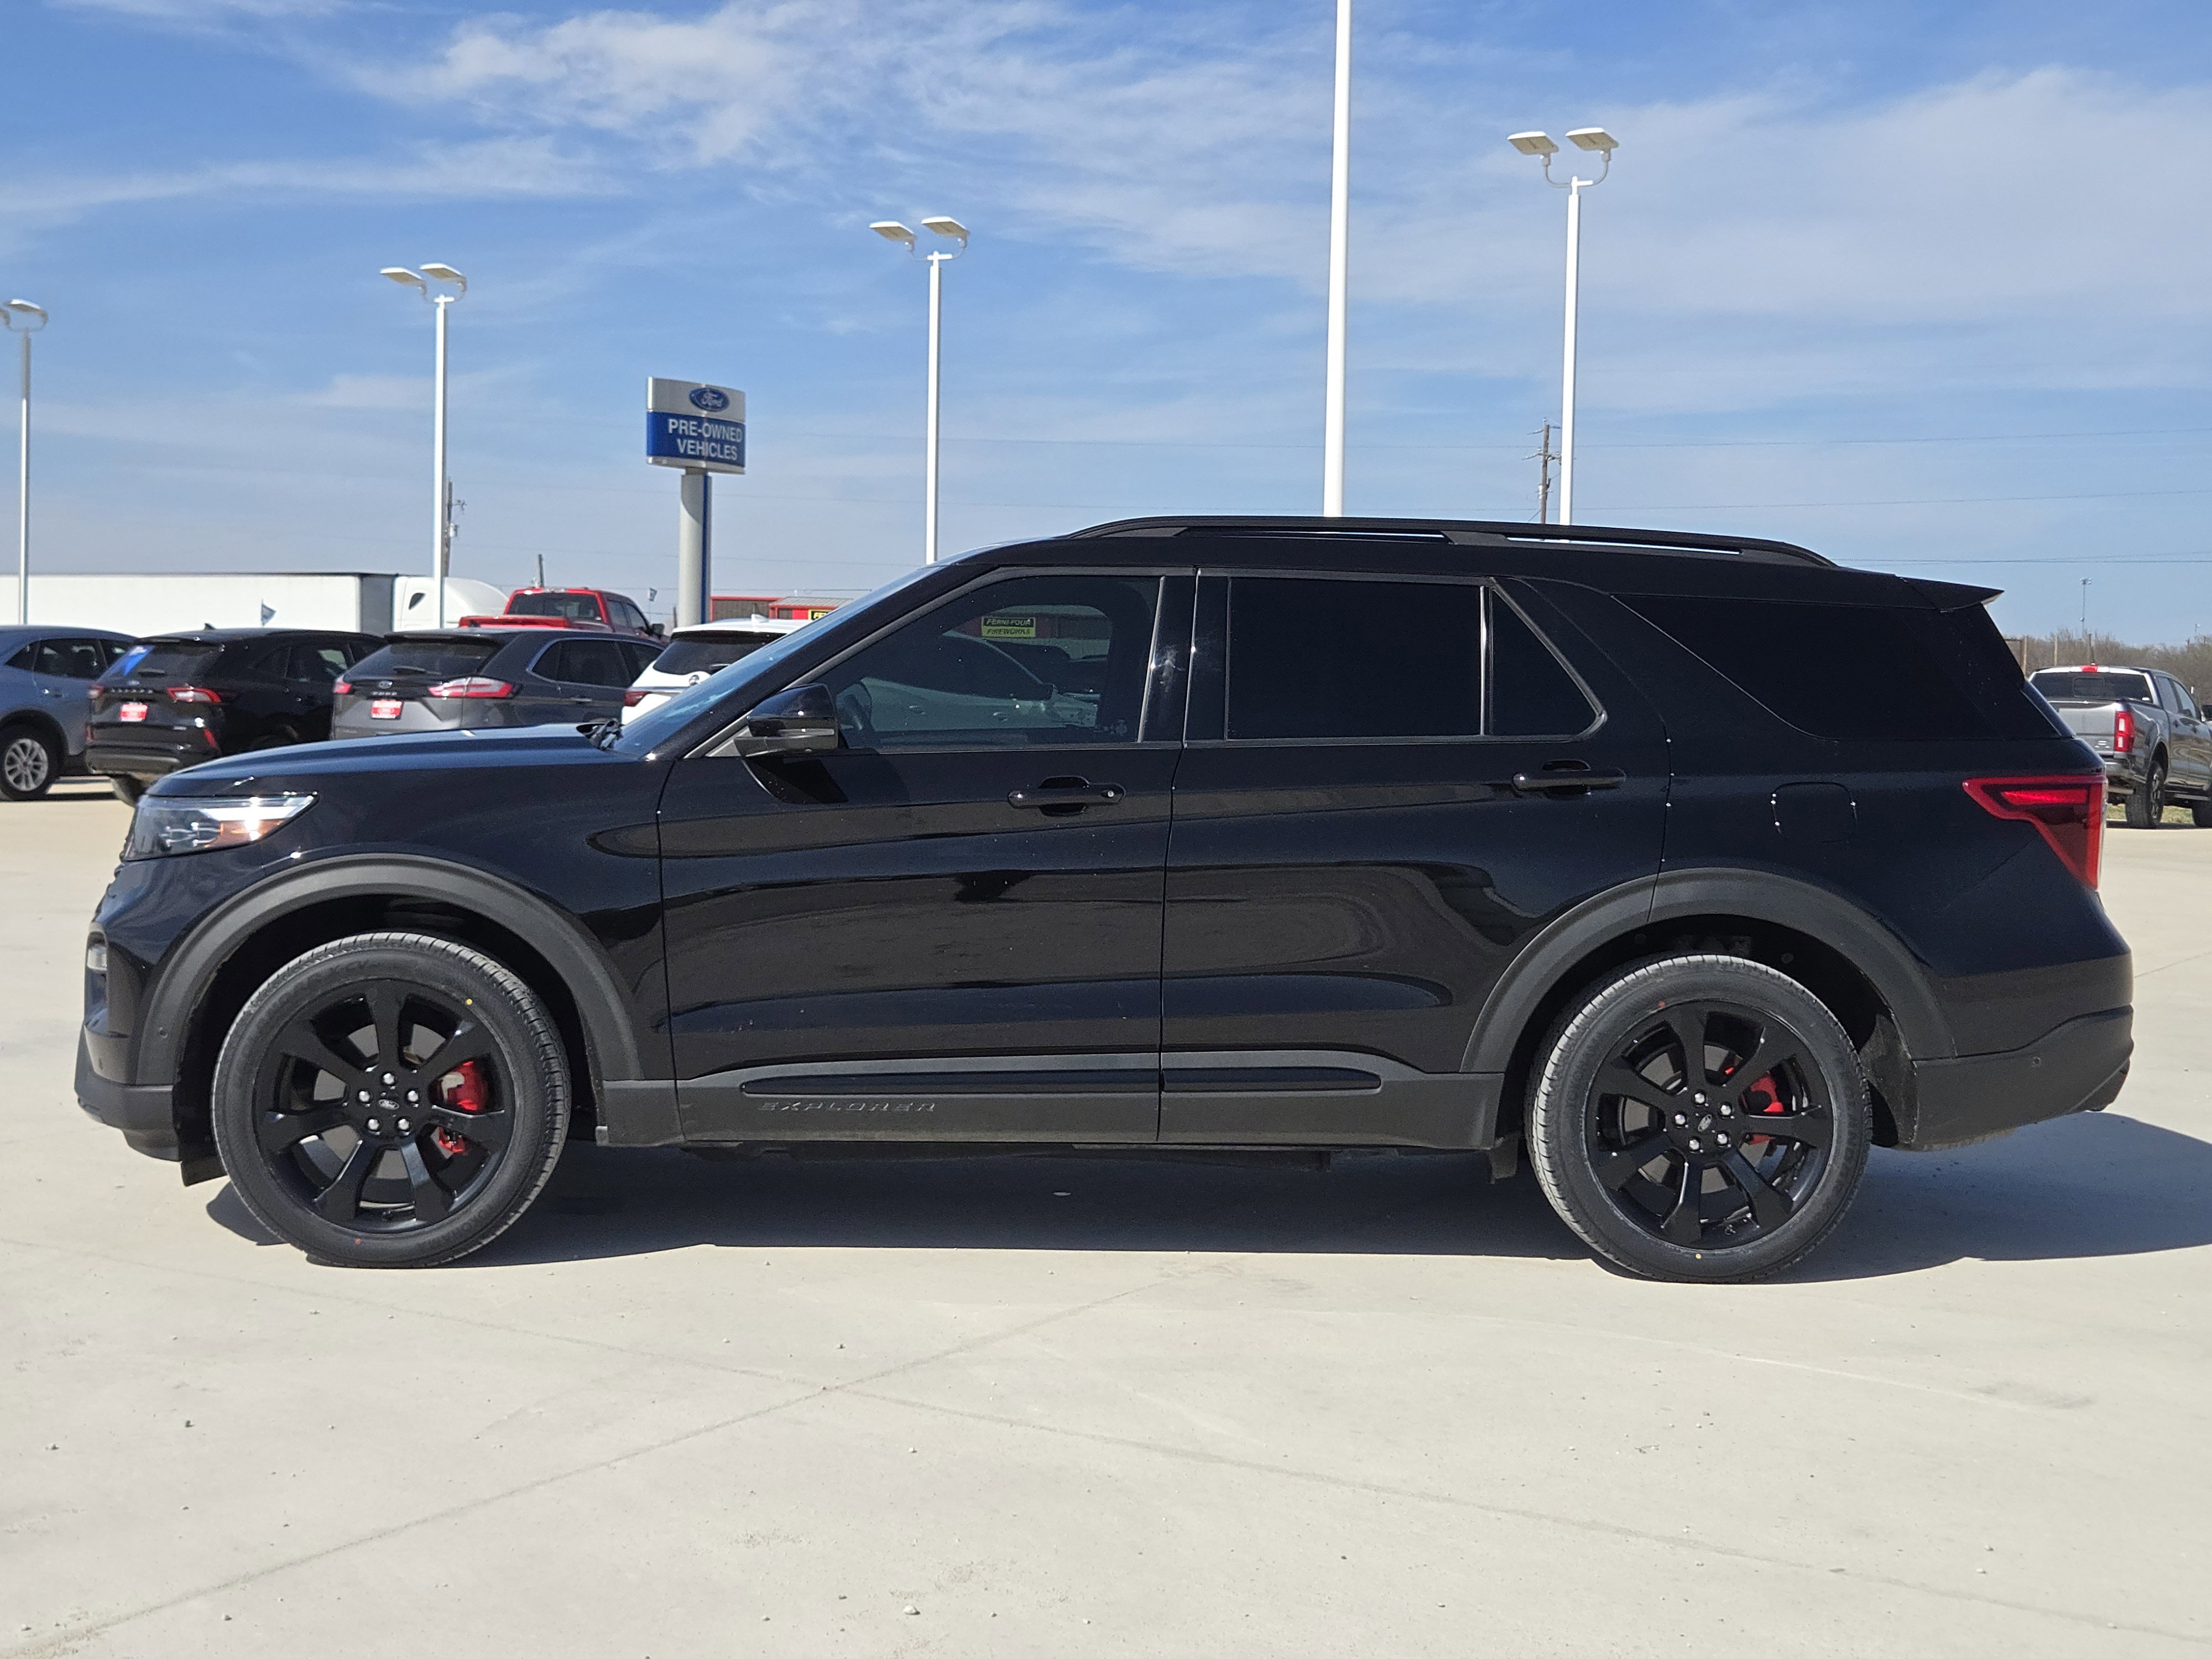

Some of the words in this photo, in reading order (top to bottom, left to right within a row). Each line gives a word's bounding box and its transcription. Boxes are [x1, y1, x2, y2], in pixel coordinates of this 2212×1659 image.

[668, 419, 742, 441] PRE-OWNED
[677, 438, 738, 460] VEHICLES
[758, 1102, 936, 1112] EXPLORER
